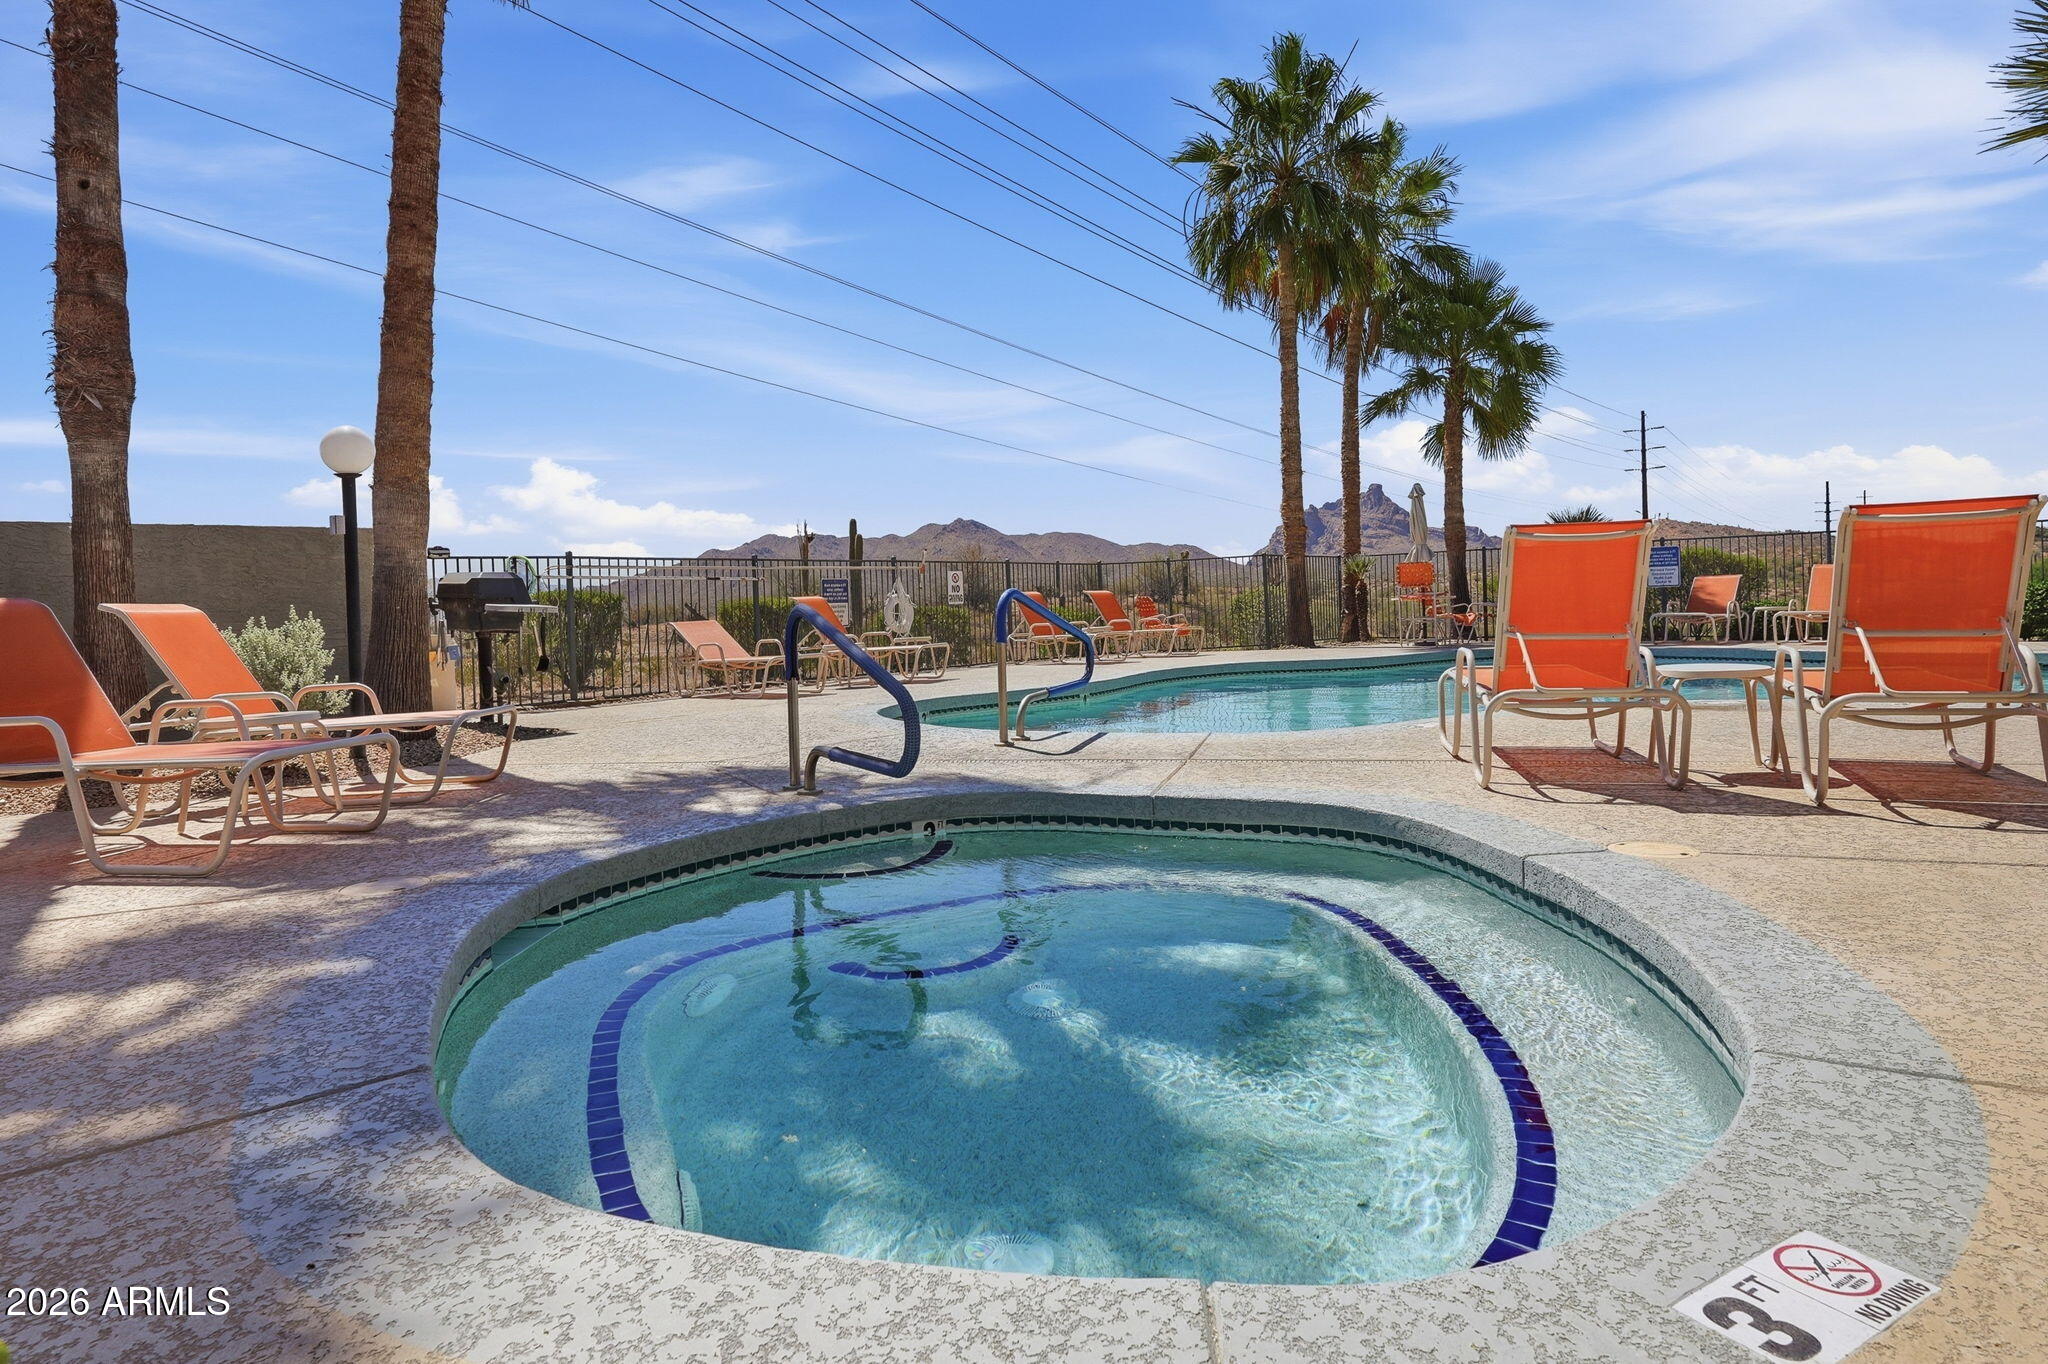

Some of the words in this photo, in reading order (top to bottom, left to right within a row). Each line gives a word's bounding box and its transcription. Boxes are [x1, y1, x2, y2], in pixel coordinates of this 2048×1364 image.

[951, 584, 961, 593] NO
[1732, 1274, 1780, 1303] FT
[1873, 1278, 1930, 1312] DIVING
[1855, 1302, 1892, 1324] NO
[1702, 1296, 1823, 1362] 3
